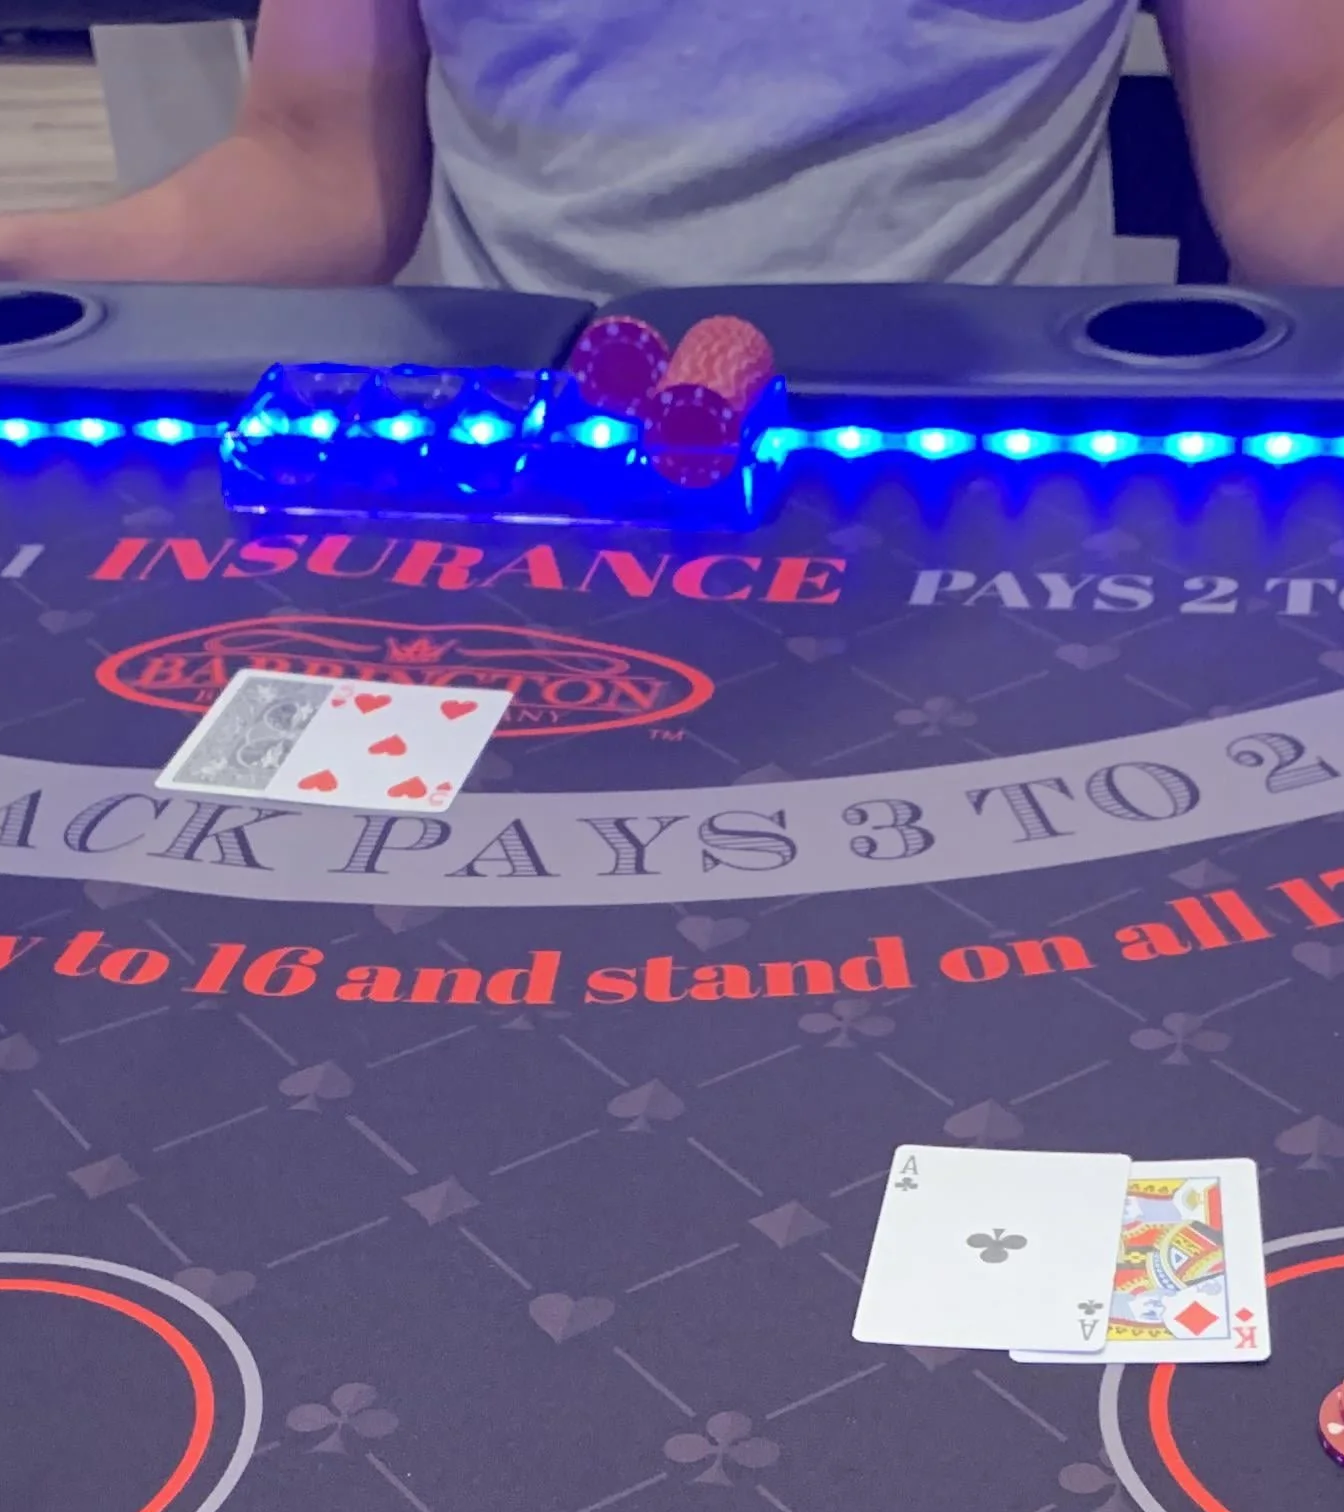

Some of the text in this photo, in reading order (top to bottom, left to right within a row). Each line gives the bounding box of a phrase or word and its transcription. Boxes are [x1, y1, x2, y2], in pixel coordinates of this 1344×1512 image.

[0, 544, 45, 578] 1
[87, 534, 849, 604] INSURANCE
[908, 570, 1155, 611] PAYS
[1179, 576, 1239, 614] 2
[327, 808, 798, 878] PAYS
[841, 798, 936, 861] 3
[965, 761, 1201, 843] TO
[1225, 732, 1342, 794] 2
[53, 930, 170, 985] to
[181, 943, 324, 997] 16
[335, 949, 563, 1005] and
[584, 936, 916, 1004] stand
[939, 933, 1097, 983] on
[1113, 889, 1276, 961] all
[899, 1154, 920, 1176] A
[1076, 1318, 1101, 1341] A
[1234, 1325, 1259, 1349] K
